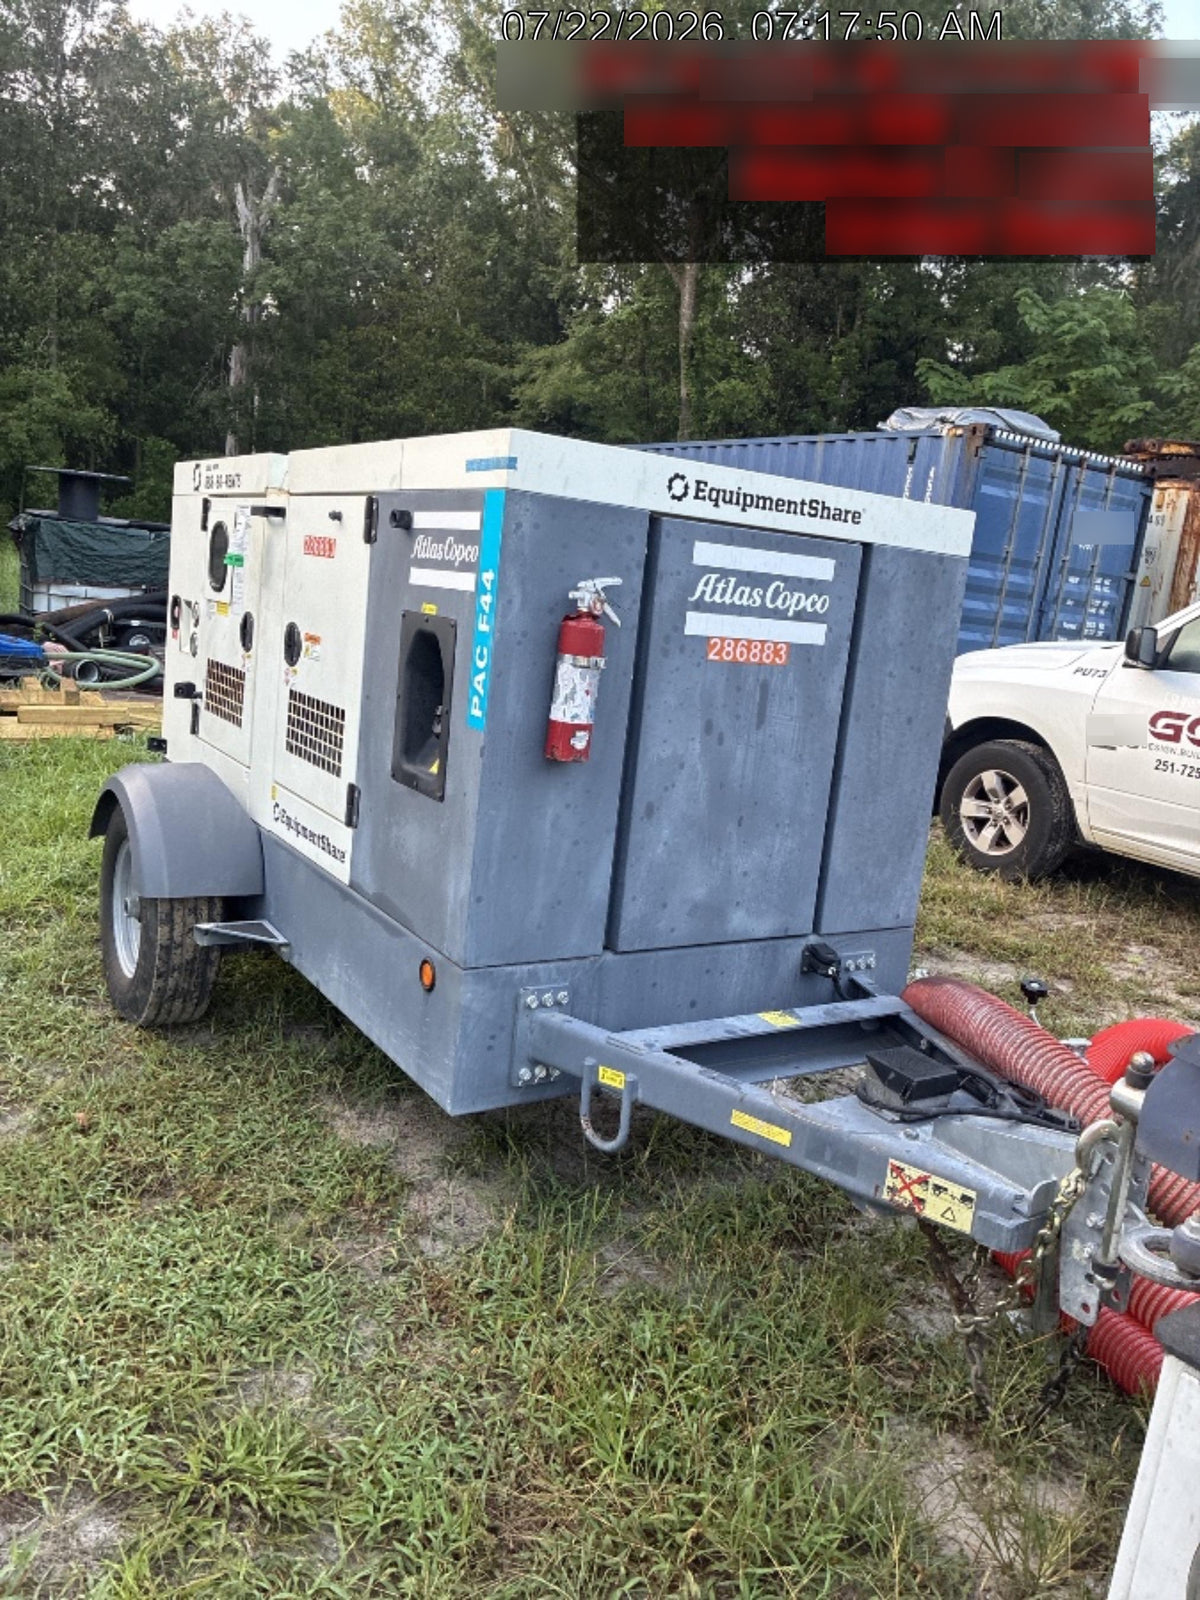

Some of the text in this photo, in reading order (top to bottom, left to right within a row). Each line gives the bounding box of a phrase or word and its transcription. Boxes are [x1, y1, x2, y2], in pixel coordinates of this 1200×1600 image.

[692, 479, 862, 525] EquipmentShare
[410, 534, 479, 568] Atlas Copco
[688, 573, 830, 618] Atlas Copco
[470, 569, 496, 718] PAC F44
[708, 638, 788, 664] 286883
